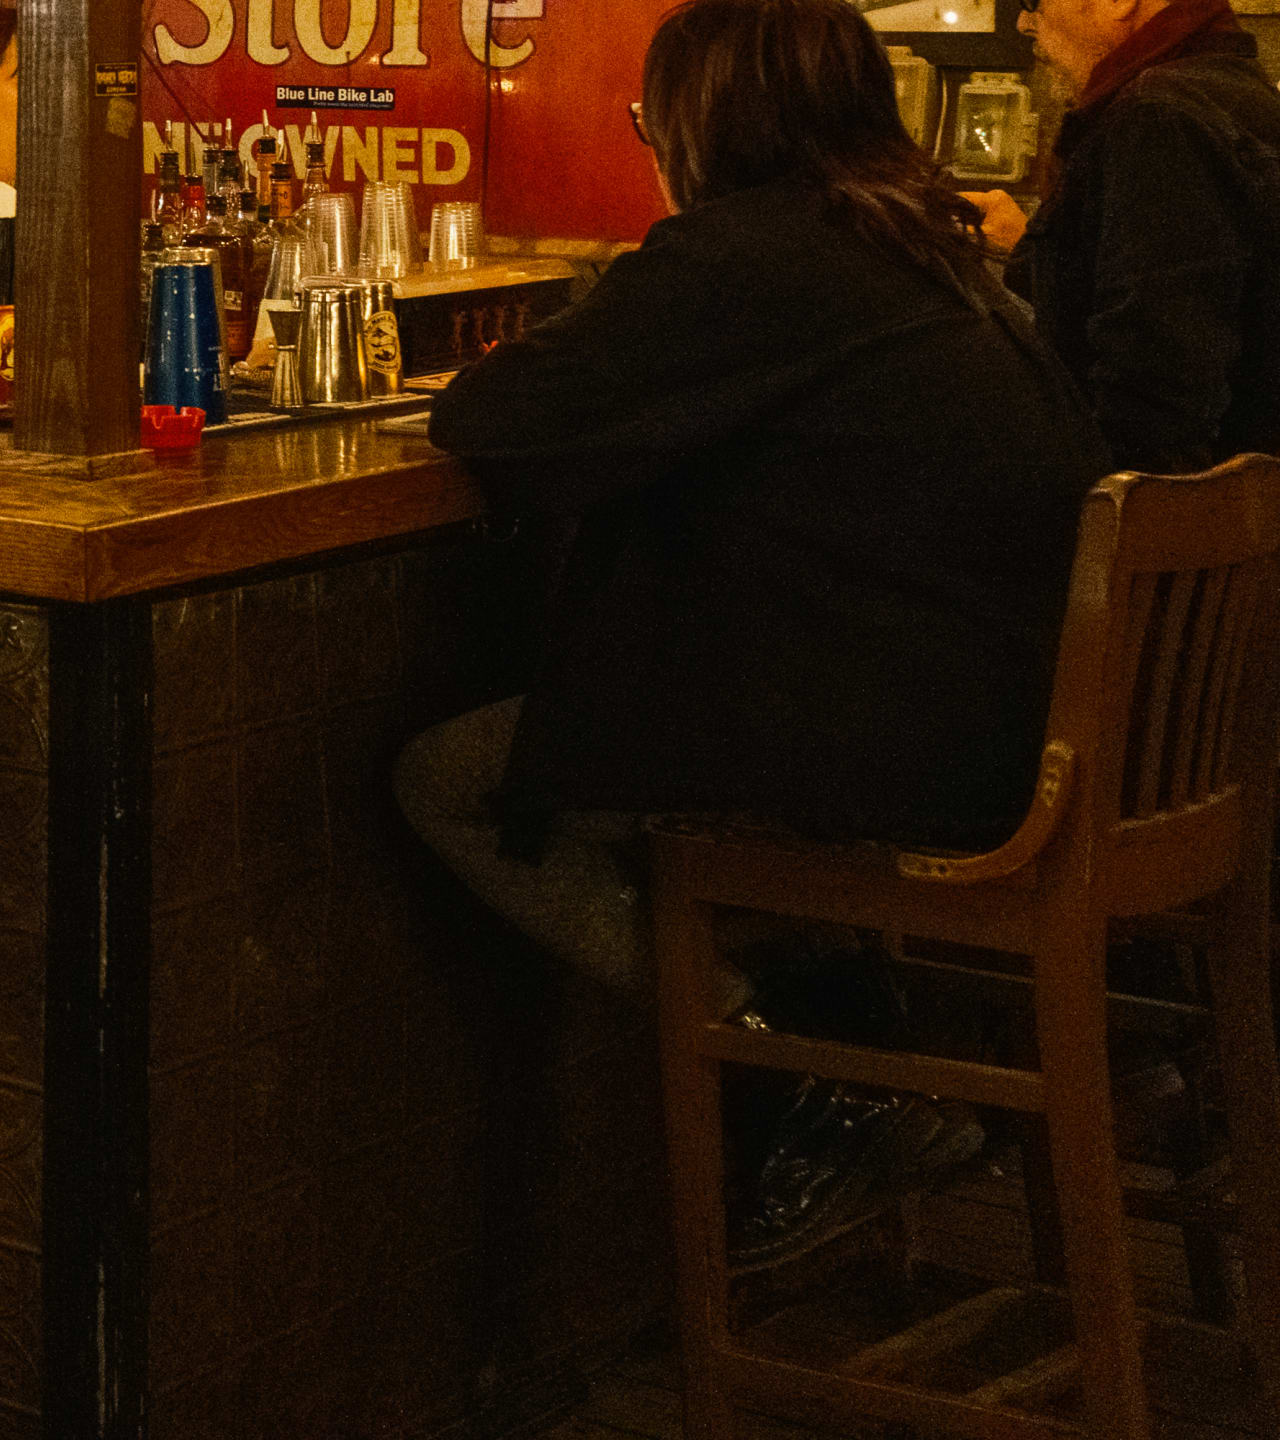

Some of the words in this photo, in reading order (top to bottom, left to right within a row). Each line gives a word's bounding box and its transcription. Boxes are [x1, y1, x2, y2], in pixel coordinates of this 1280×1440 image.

[276, 86, 306, 101] Blue
[307, 88, 335, 102] Line
[337, 89, 367, 103] Bike
[369, 90, 394, 104] Lab
[238, 123, 472, 186] OWNED
